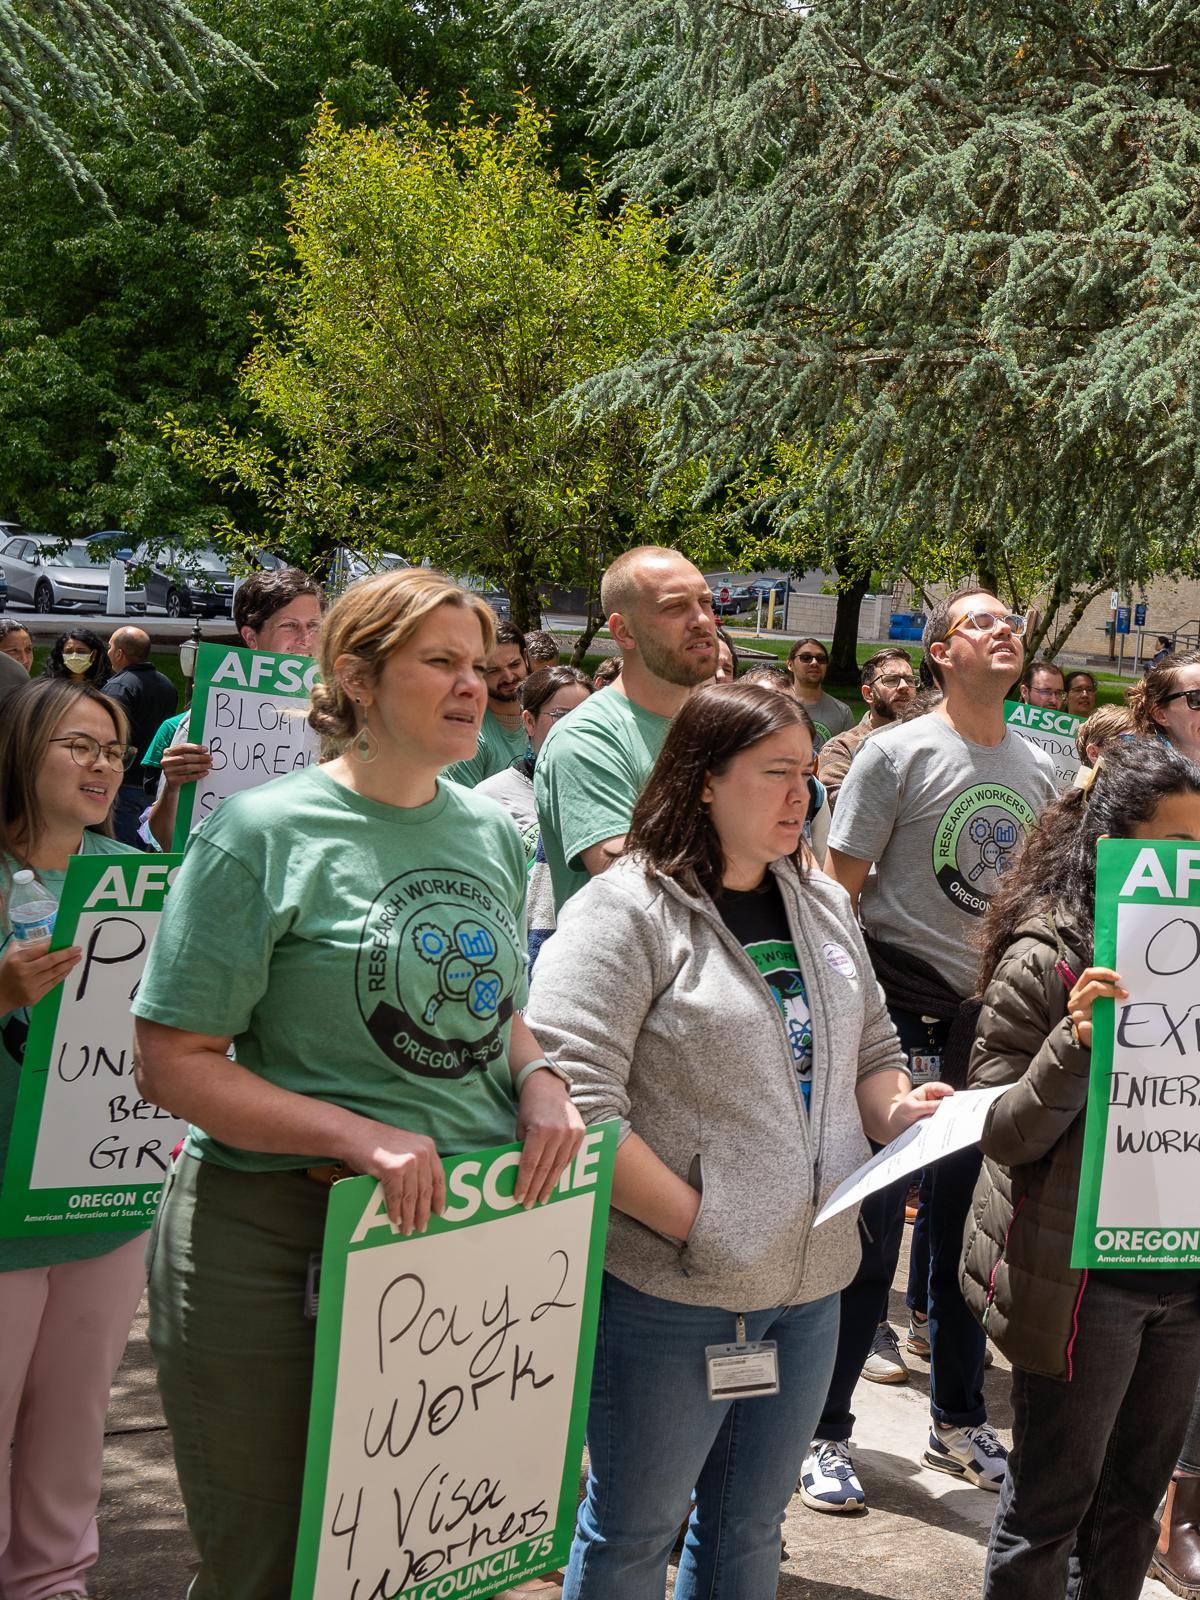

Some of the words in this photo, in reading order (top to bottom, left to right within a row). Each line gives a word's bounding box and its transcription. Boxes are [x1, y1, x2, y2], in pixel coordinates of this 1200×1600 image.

[940, 795, 975, 857] RESEARCH
[975, 789, 1025, 815] WORKERS
[368, 893, 408, 993] RESEARCH
[403, 879, 493, 911] WORKERS
[393, 1031, 461, 1069] OREGON
[24, 1213, 63, 1222] American
[65, 1210, 108, 1220] Federation
[111, 1209, 121, 1217] of
[121, 1208, 144, 1217] State,
[68, 1192, 137, 1208] OREGON
[1094, 1230, 1199, 1251] OREGON
[1097, 1254, 1136, 1263] American
[1137, 1254, 1179, 1263] Federation
[1180, 1253, 1189, 1263] of
[378, 1273, 520, 1378] Pay
[530, 1250, 576, 1321] 2
[331, 1487, 363, 1570] 4
[394, 1464, 506, 1548] Visa
[418, 1548, 520, 1600] COUNCIL
[527, 1534, 554, 1562] 75
[472, 1577, 508, 1599] Municipal
[508, 1561, 547, 1584] Employees
